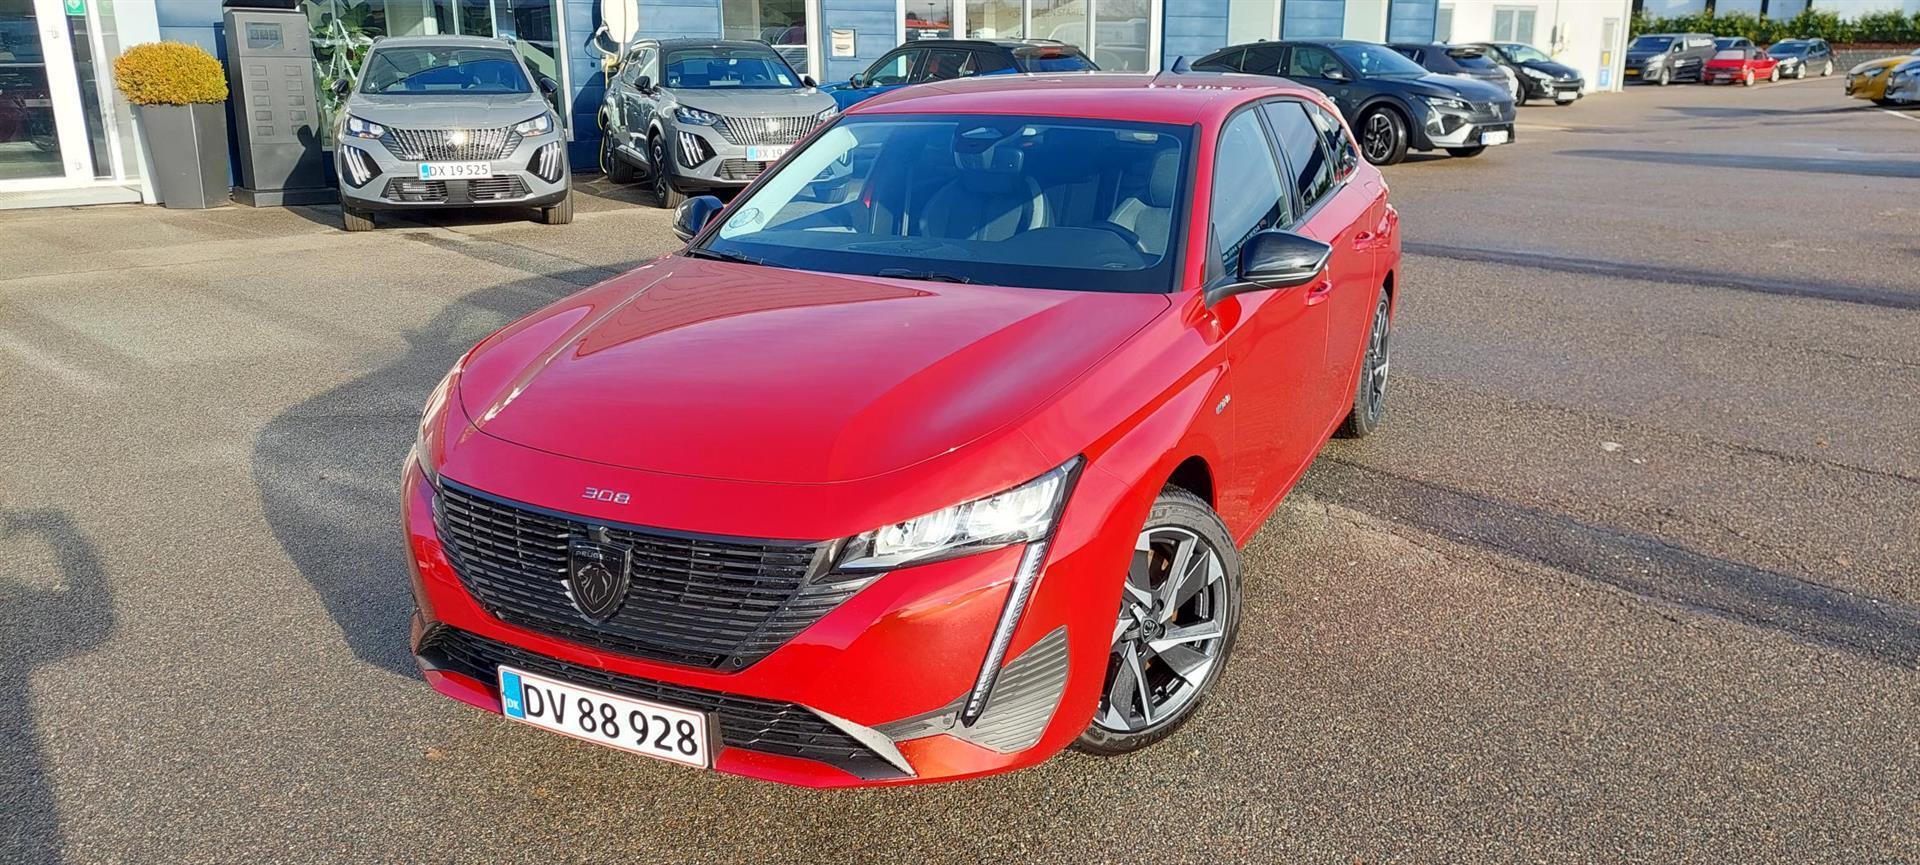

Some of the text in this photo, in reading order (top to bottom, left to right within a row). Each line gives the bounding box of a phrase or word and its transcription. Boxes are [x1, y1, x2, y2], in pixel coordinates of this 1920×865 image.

[429, 165, 488, 177] DX 19 525
[582, 487, 630, 504] 308
[507, 698, 520, 711] DK
[523, 683, 698, 756] DV 88 928
